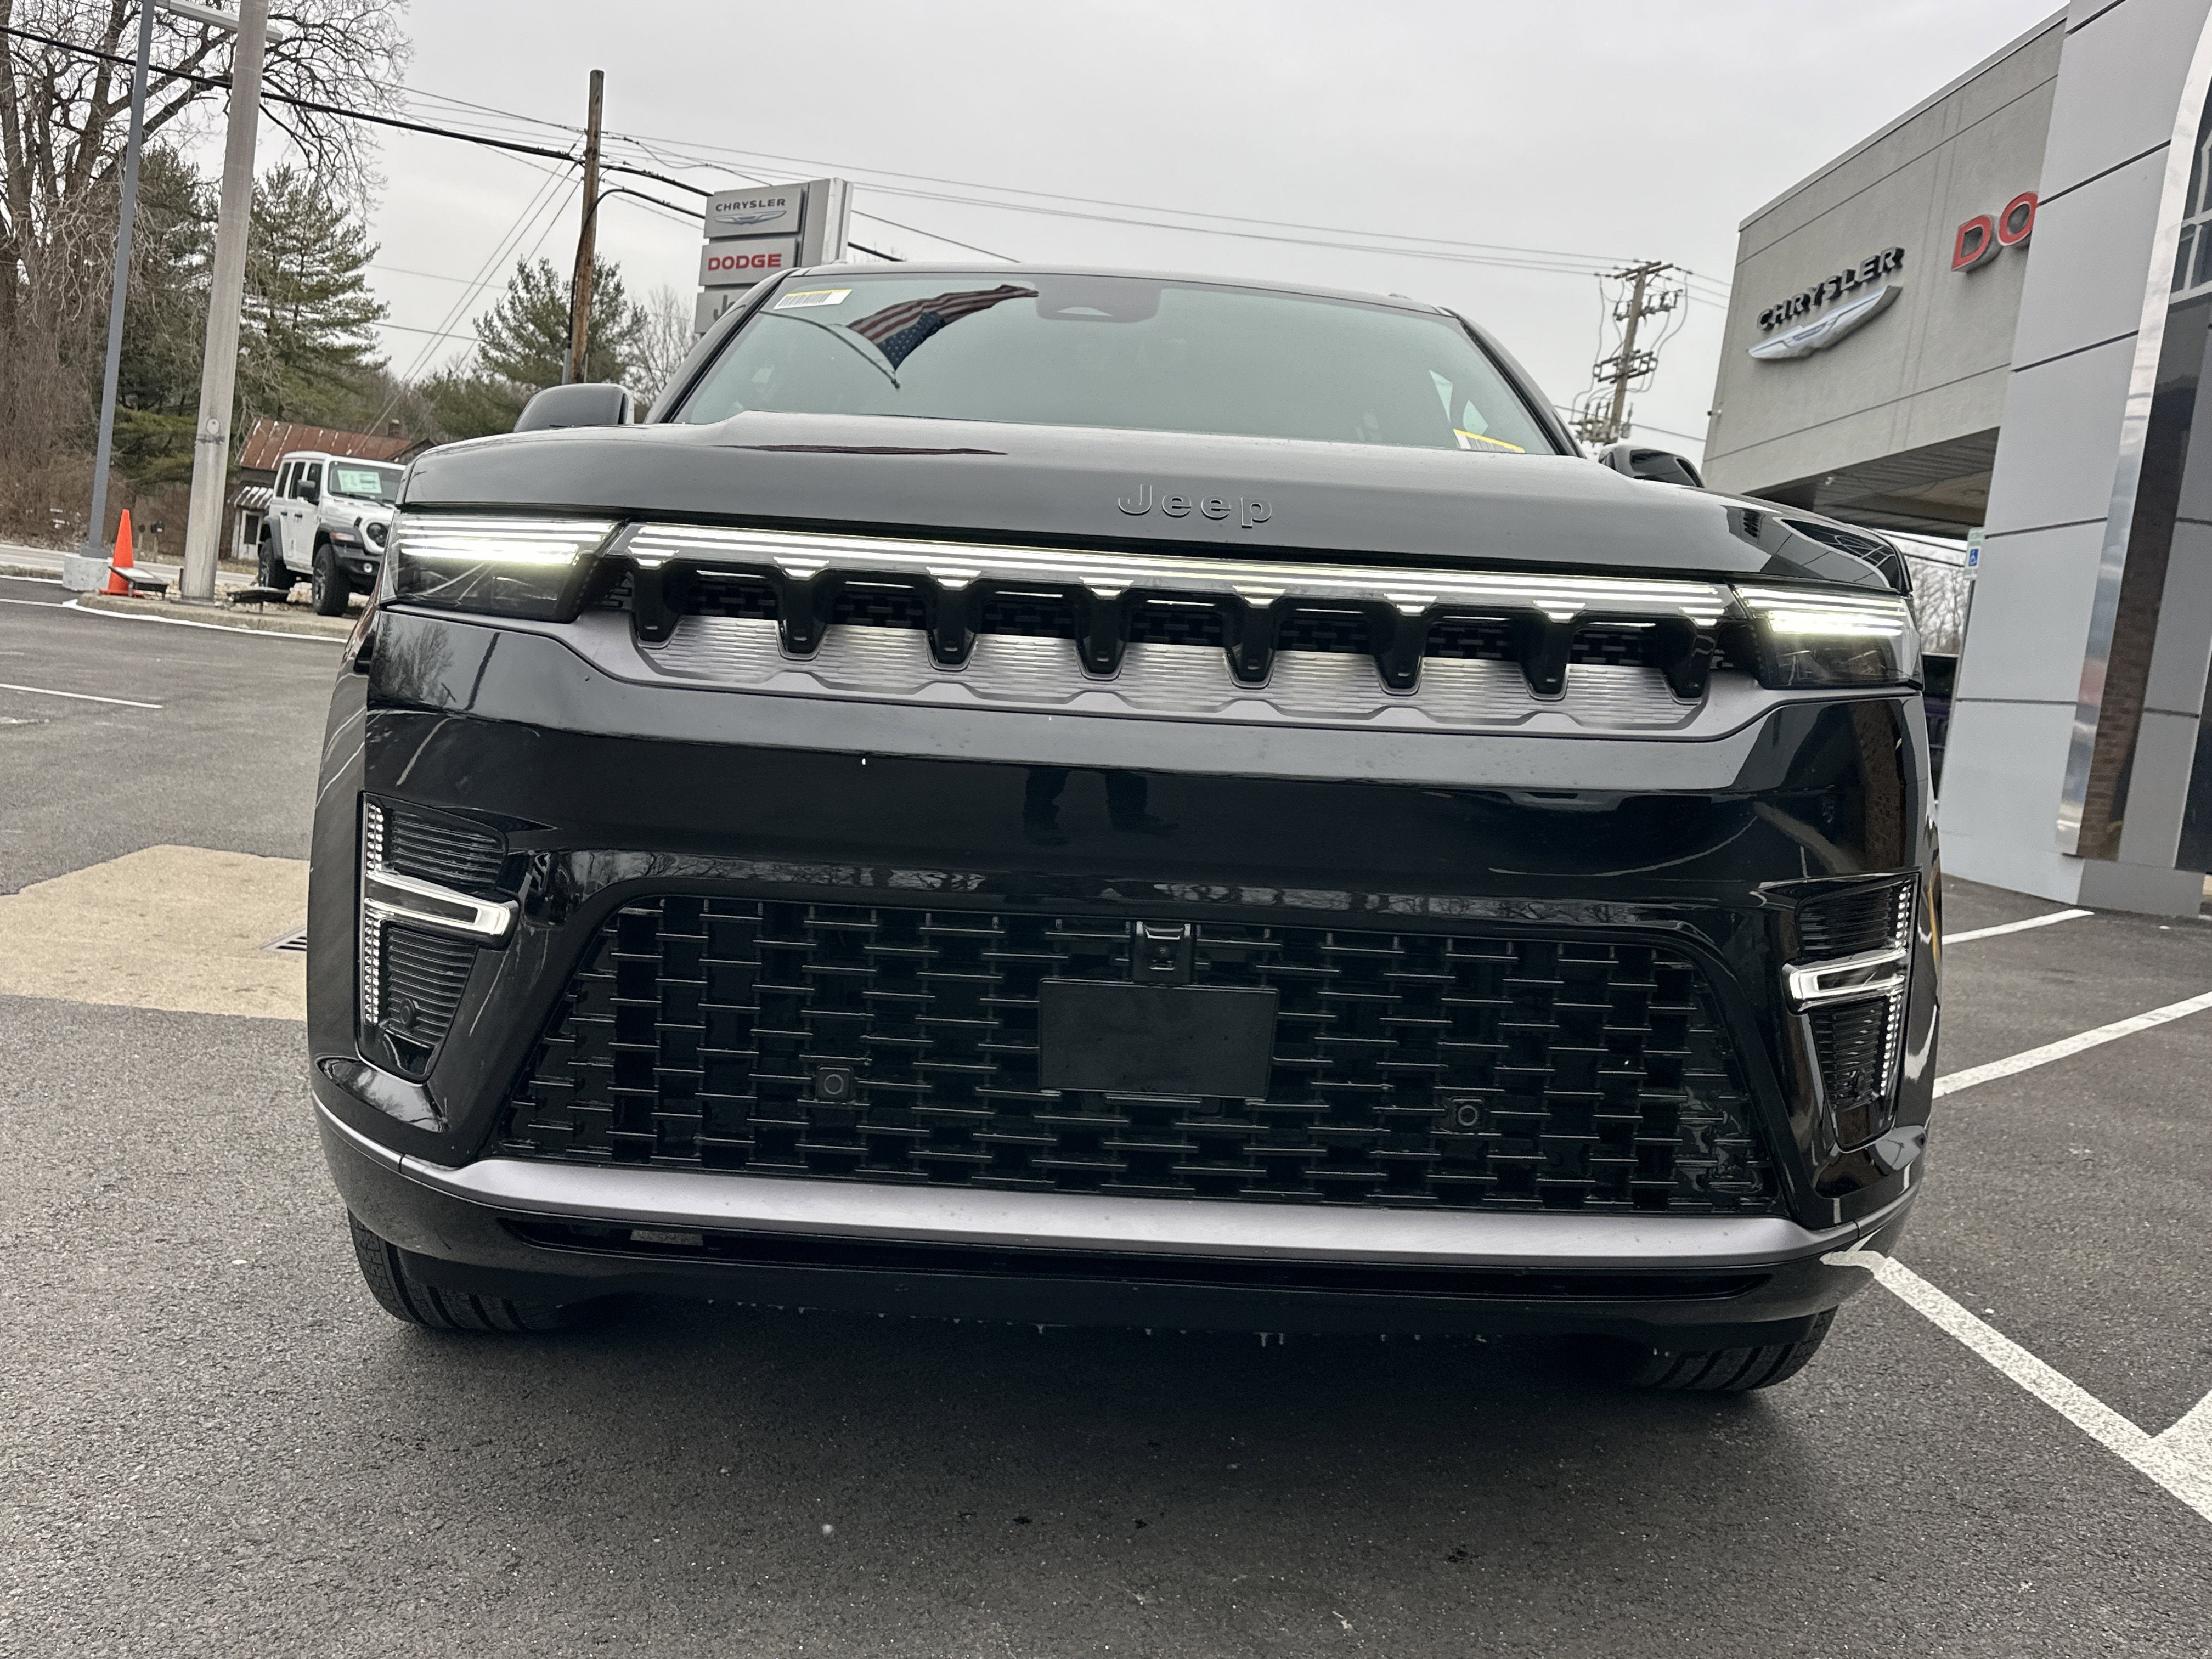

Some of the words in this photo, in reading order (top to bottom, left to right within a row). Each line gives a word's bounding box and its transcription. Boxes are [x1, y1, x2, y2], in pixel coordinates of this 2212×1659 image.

[715, 198, 786, 212] CHRYSLER
[708, 253, 782, 271] DODGE
[1757, 246, 1905, 331] CHRYSLER
[1118, 483, 1273, 528] Jeep
